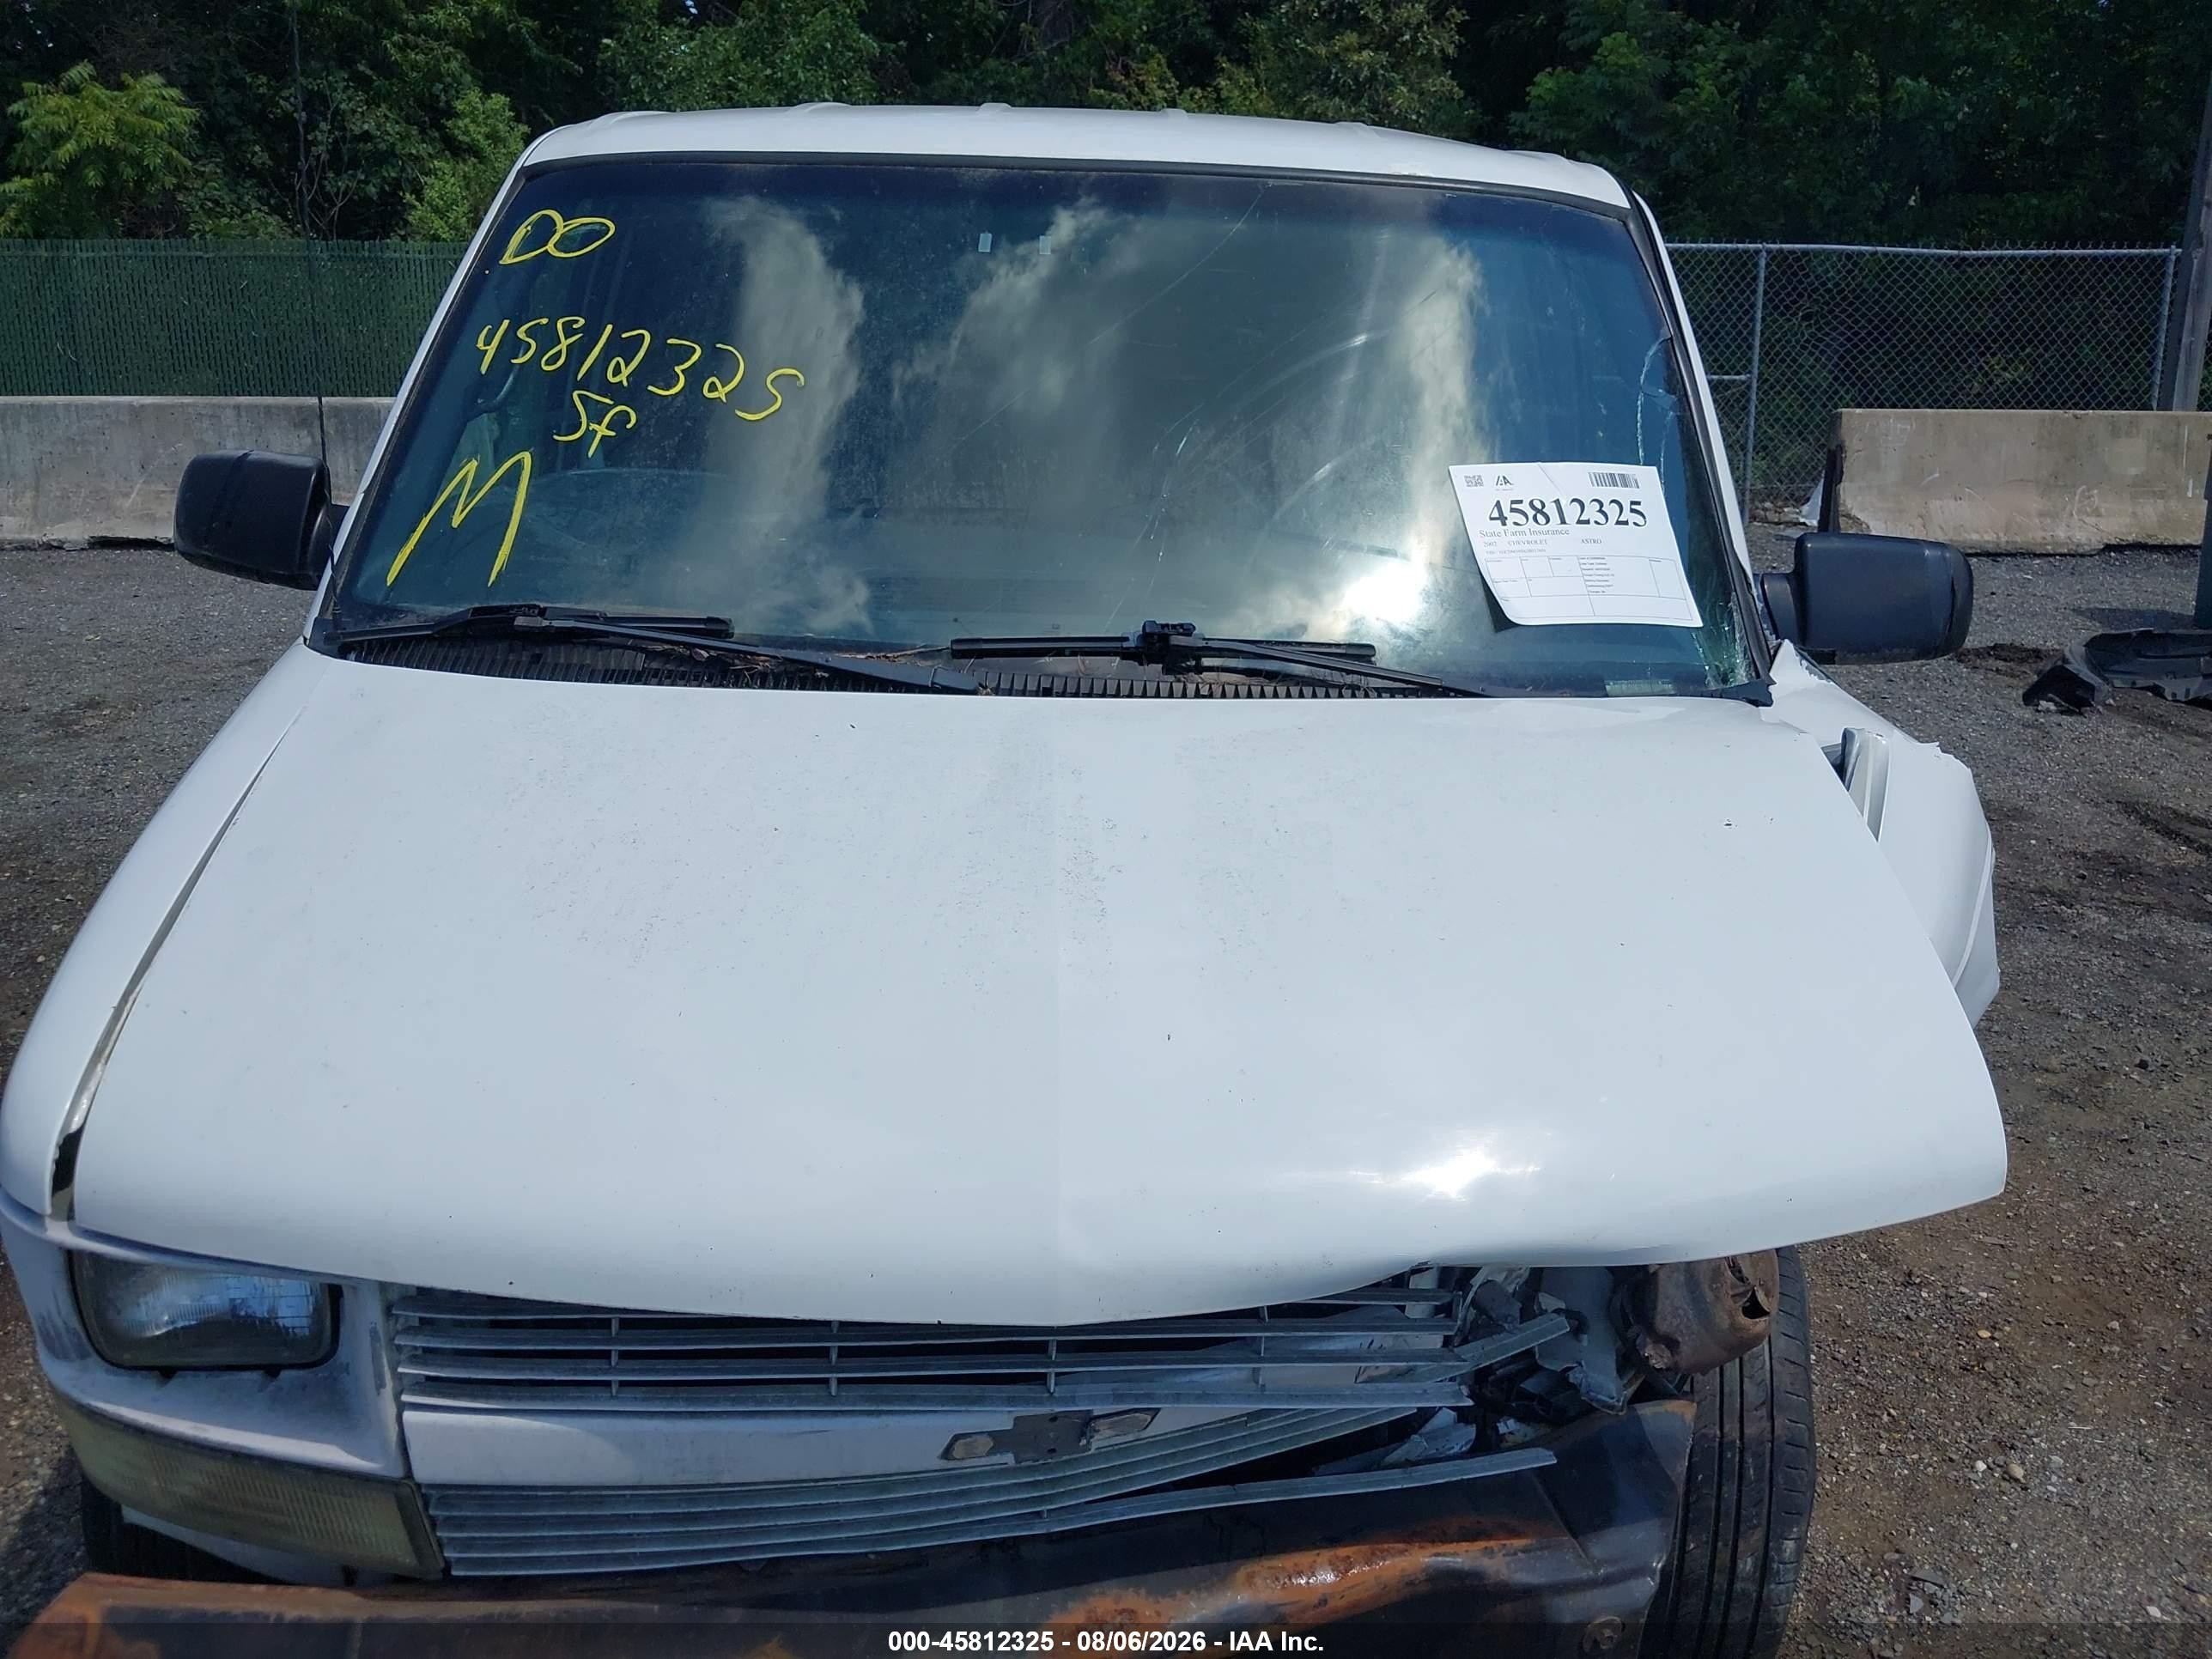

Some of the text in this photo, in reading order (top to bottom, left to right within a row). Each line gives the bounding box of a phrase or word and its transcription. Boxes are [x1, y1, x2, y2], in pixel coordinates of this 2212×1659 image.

[476, 316, 805, 421] 45812325
[386, 450, 533, 586] M
[1488, 497, 1647, 527] 45812325
[1479, 527, 1570, 538] State Farm Insurance
[1507, 538, 1548, 547] CHEVROLET
